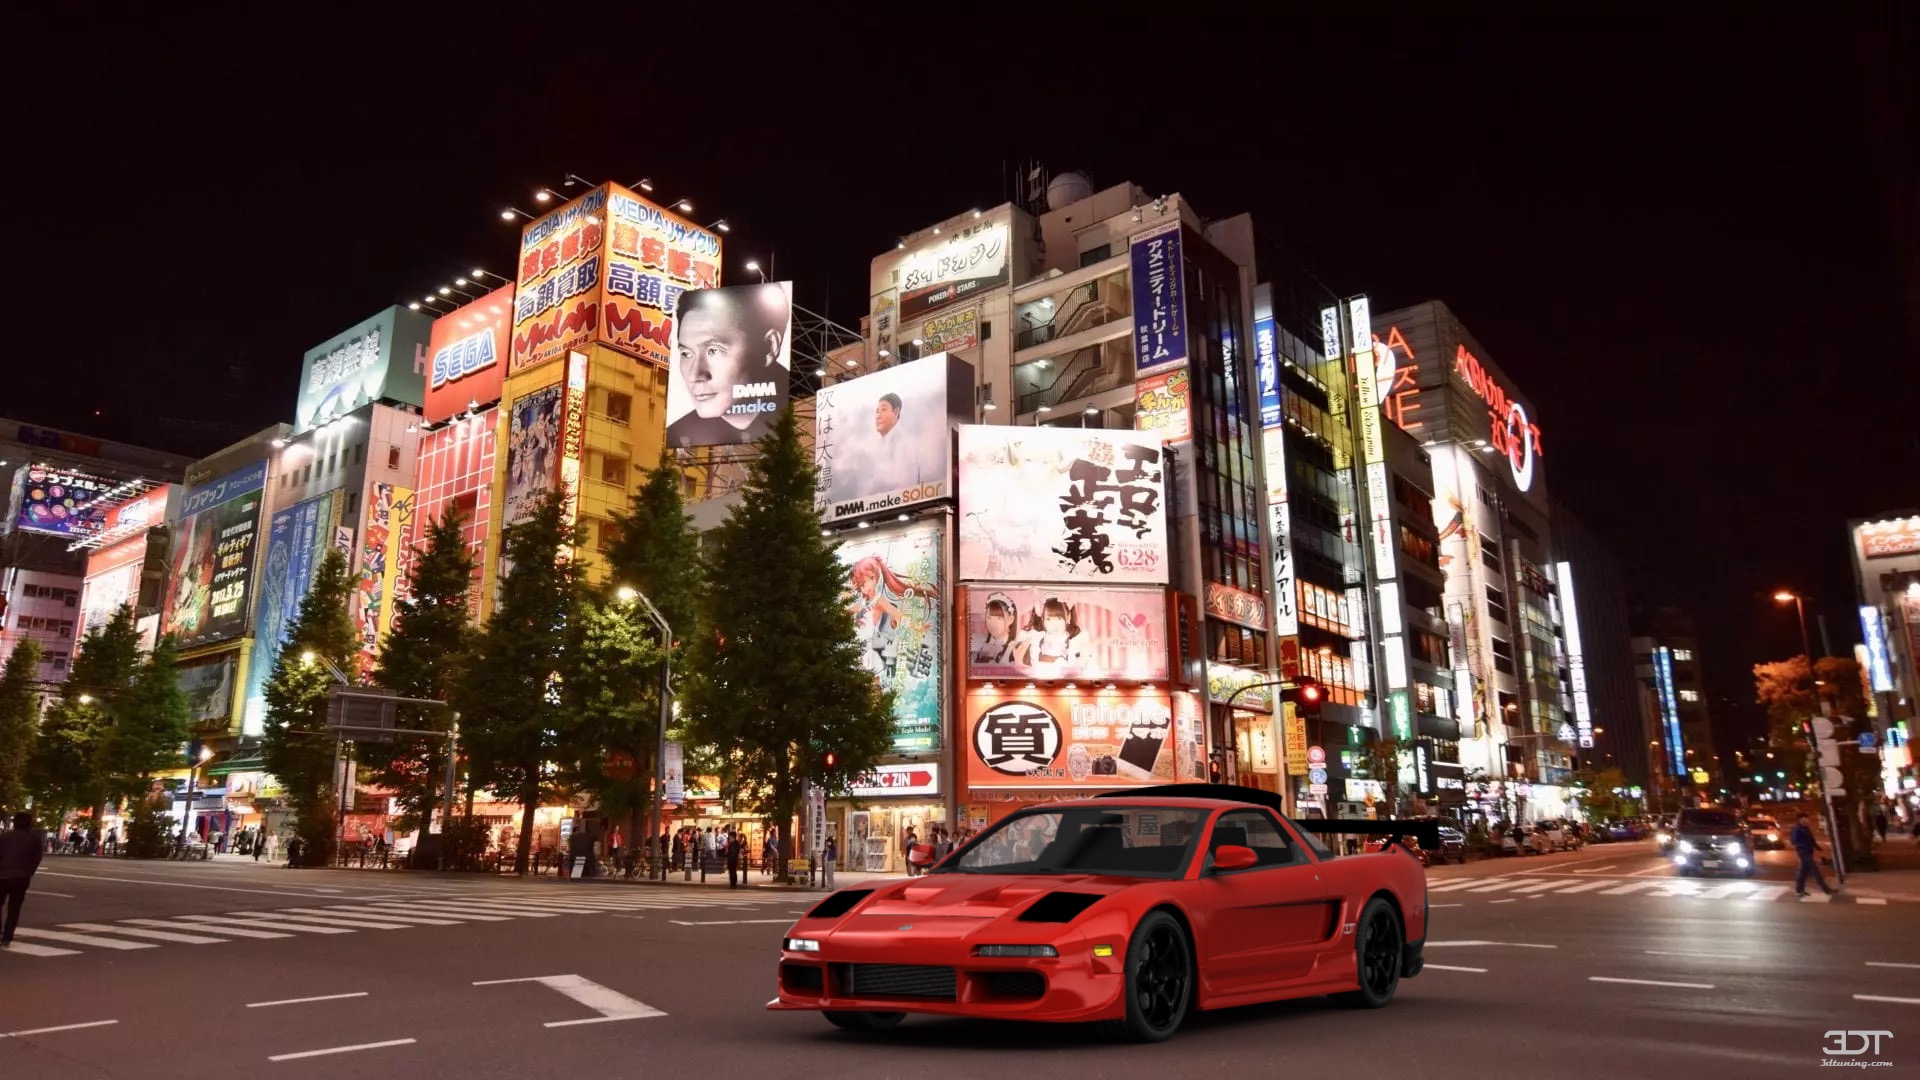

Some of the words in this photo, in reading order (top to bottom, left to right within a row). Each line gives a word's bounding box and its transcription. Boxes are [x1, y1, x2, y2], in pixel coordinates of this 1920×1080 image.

[613, 194, 719, 257] MEDIAリサイクル
[521, 223, 602, 284] 激安販売
[517, 255, 598, 325] 高額買取
[928, 291, 947, 304] POKER
[957, 281, 977, 294] STARS
[514, 301, 598, 368] Mulan
[615, 335, 650, 353] ムーラン
[433, 329, 496, 386] SEGA
[543, 343, 562, 358] AKIBA
[732, 382, 777, 398] DMM
[1139, 391, 1186, 412] まんが
[184, 481, 227, 512] ソフマップ
[902, 482, 943, 502] solar
[984, 712, 1052, 768] 質
[892, 773, 911, 787] ZIN
